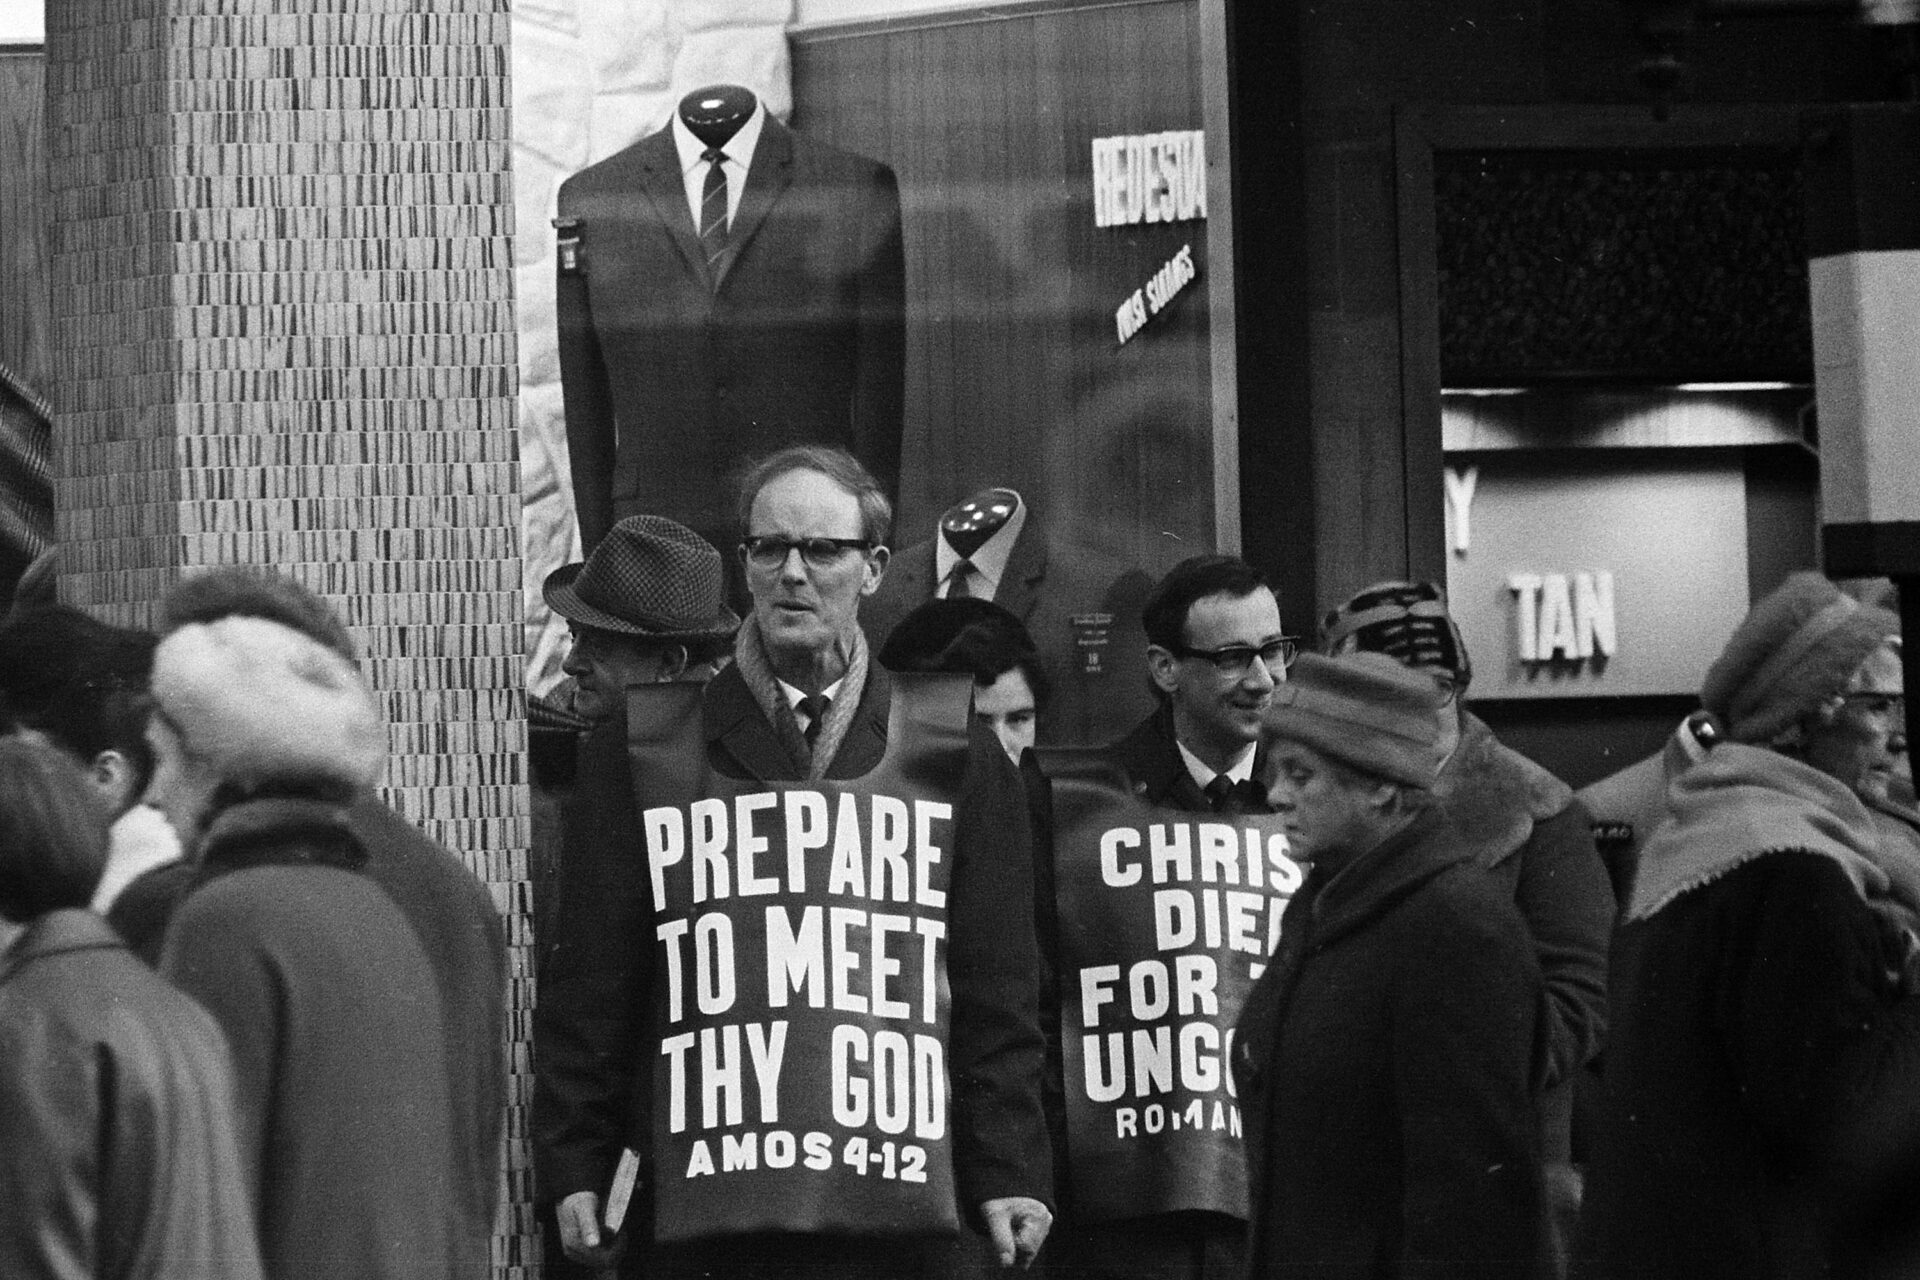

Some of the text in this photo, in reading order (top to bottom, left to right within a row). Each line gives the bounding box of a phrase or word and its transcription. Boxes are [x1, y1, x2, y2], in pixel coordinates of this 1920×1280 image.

[1508, 572, 1615, 661] TAN
[644, 790, 953, 912] PREPARE
[656, 905, 946, 1025] TO MEET
[1080, 954, 1219, 1028] FOR
[661, 1020, 946, 1141] THY GOD
[1082, 1021, 1237, 1102] UNG
[686, 1130, 928, 1184] AMOS 4-12
